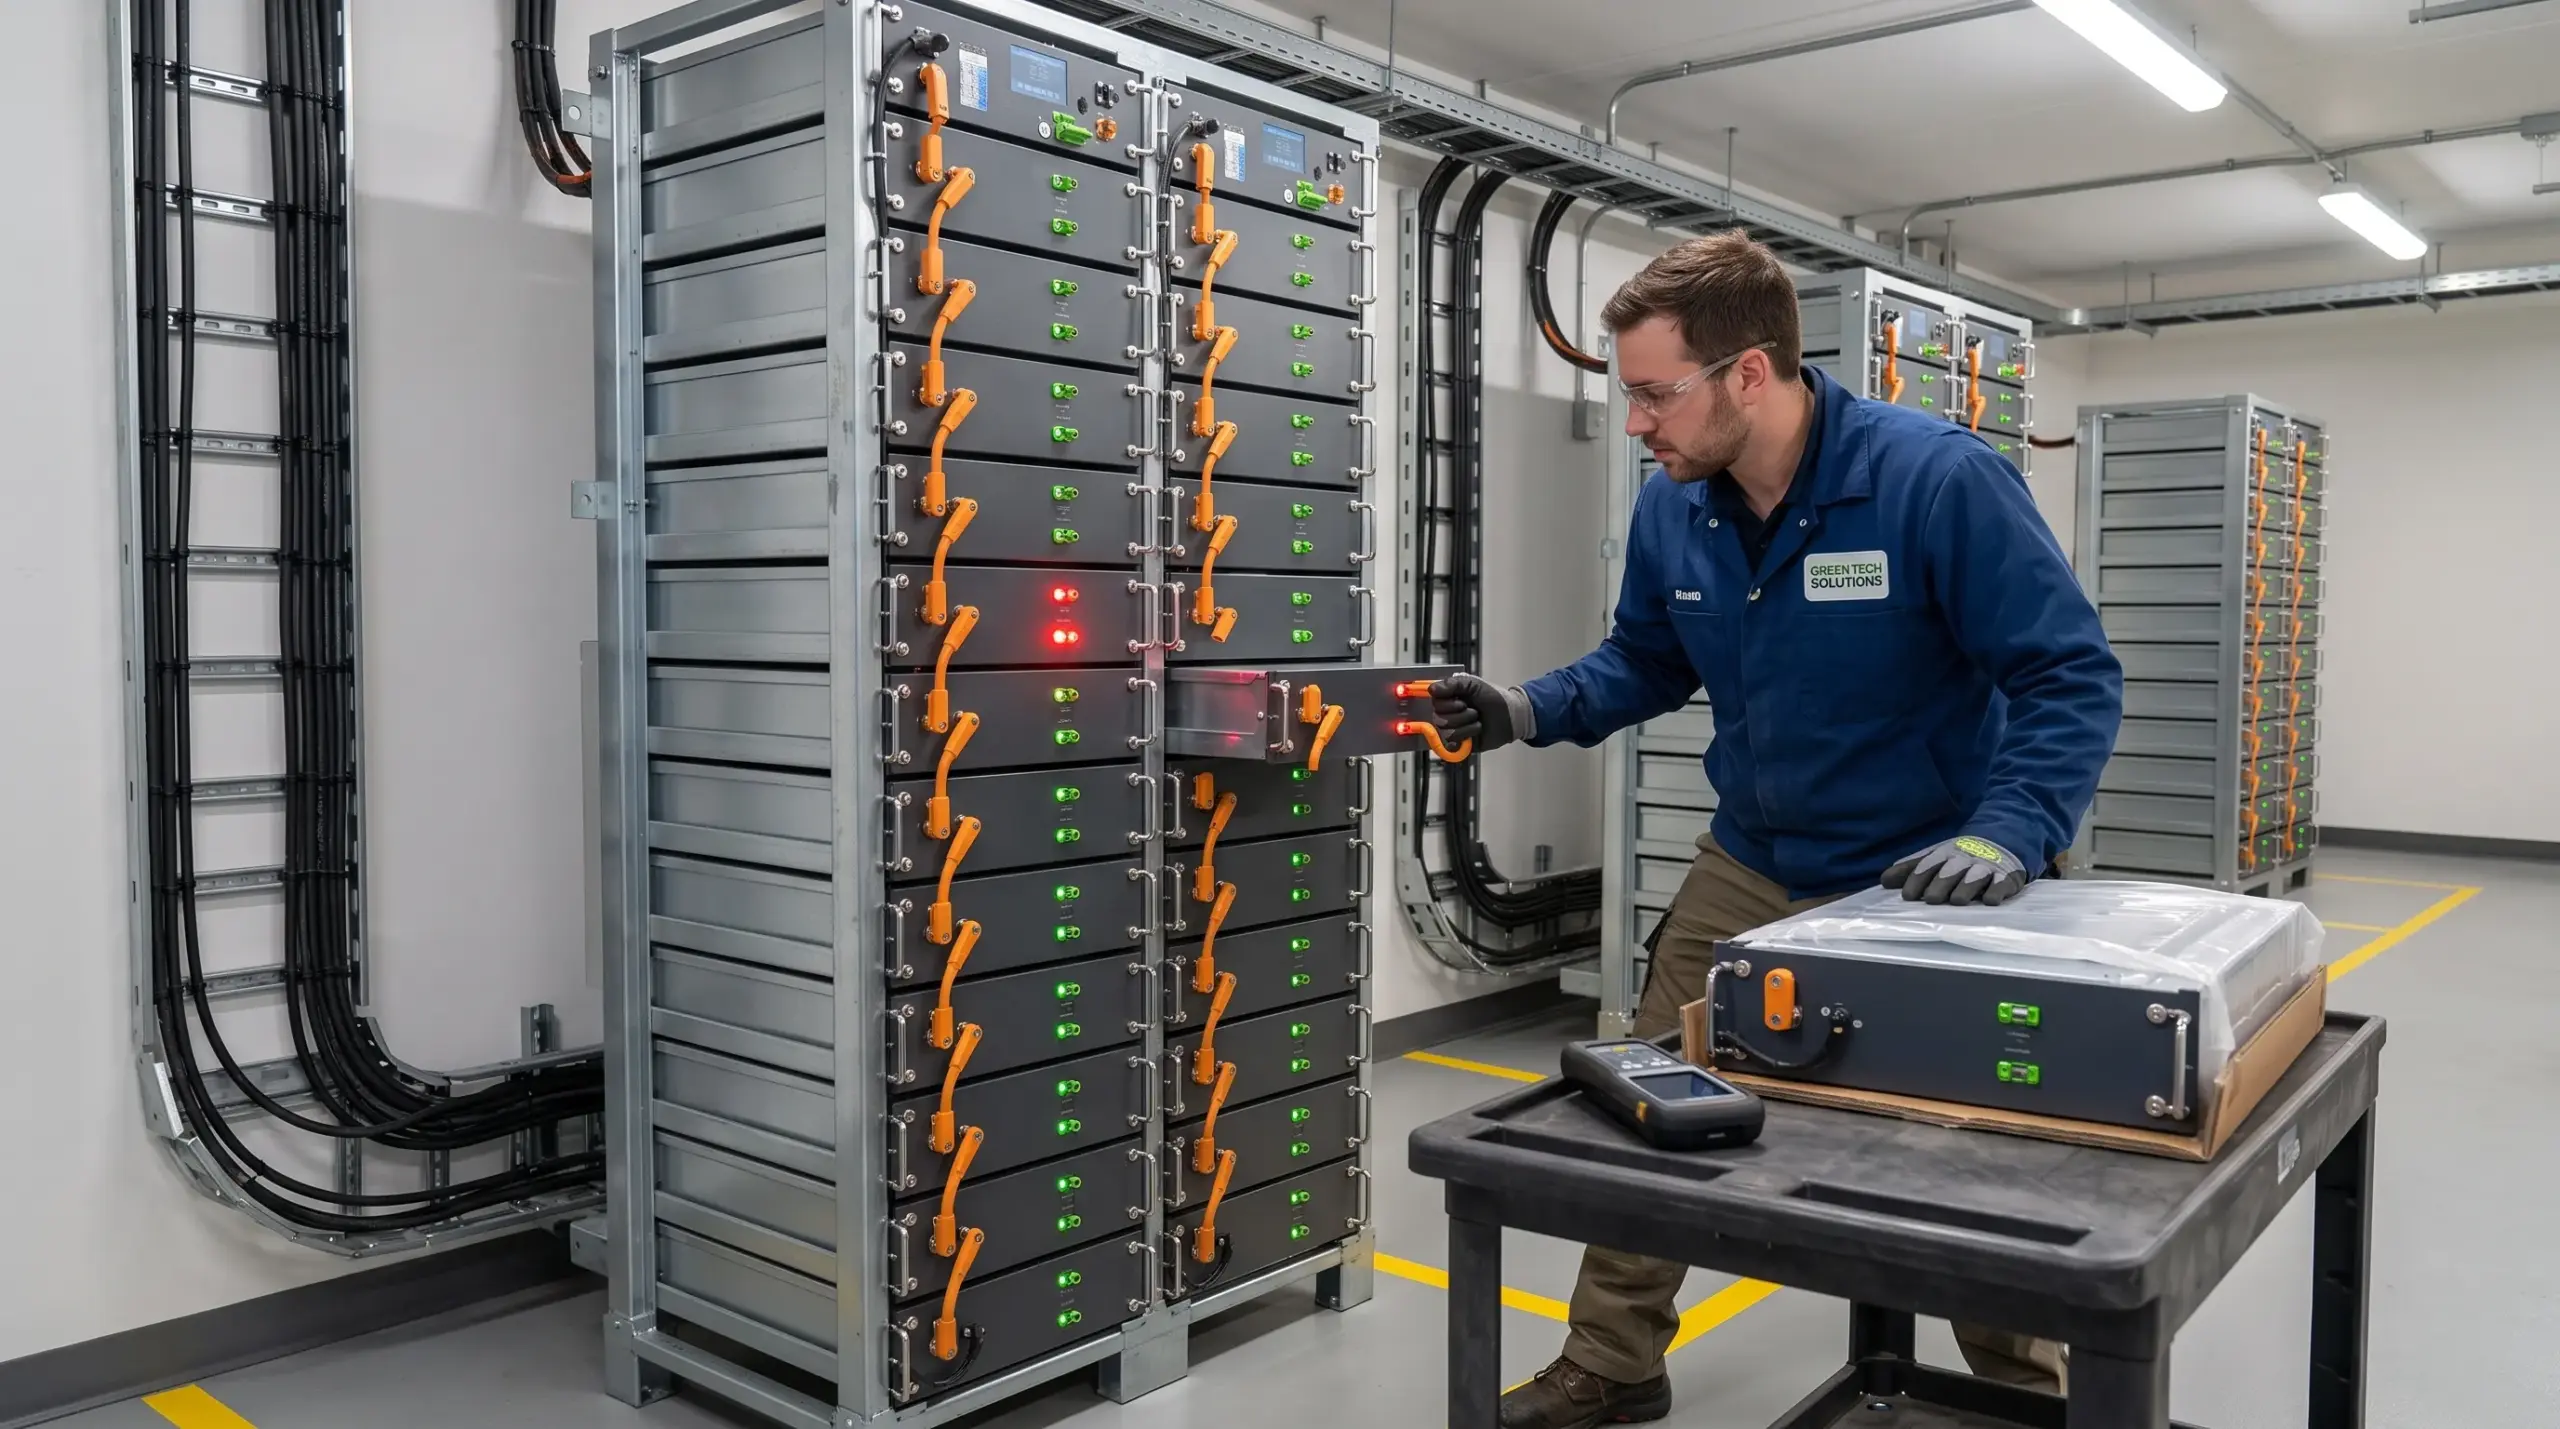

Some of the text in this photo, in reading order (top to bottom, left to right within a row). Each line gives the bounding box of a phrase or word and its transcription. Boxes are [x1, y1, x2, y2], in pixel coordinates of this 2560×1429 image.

[1811, 562, 1882, 576] GREEN TECH
[1811, 575, 1883, 589] SOLUTIONS
